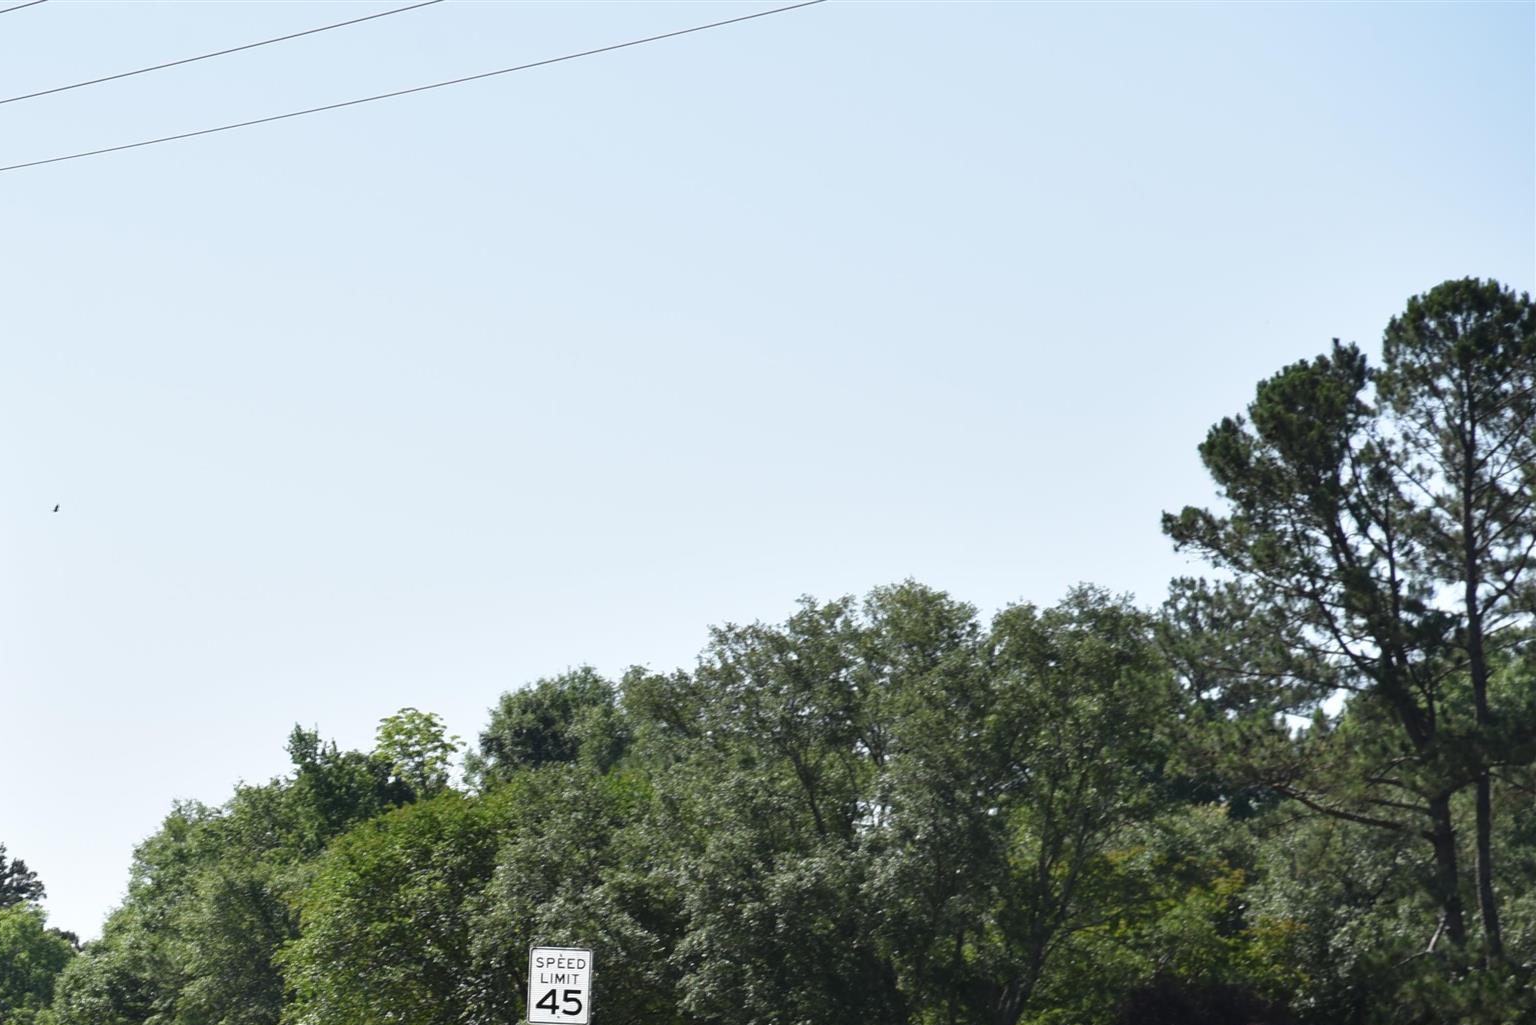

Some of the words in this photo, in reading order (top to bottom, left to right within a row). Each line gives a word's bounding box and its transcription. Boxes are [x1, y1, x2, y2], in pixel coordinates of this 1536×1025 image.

[536, 957, 586, 969] SPEED
[541, 973, 579, 984] LIMIT
[536, 989, 582, 1016] 45
